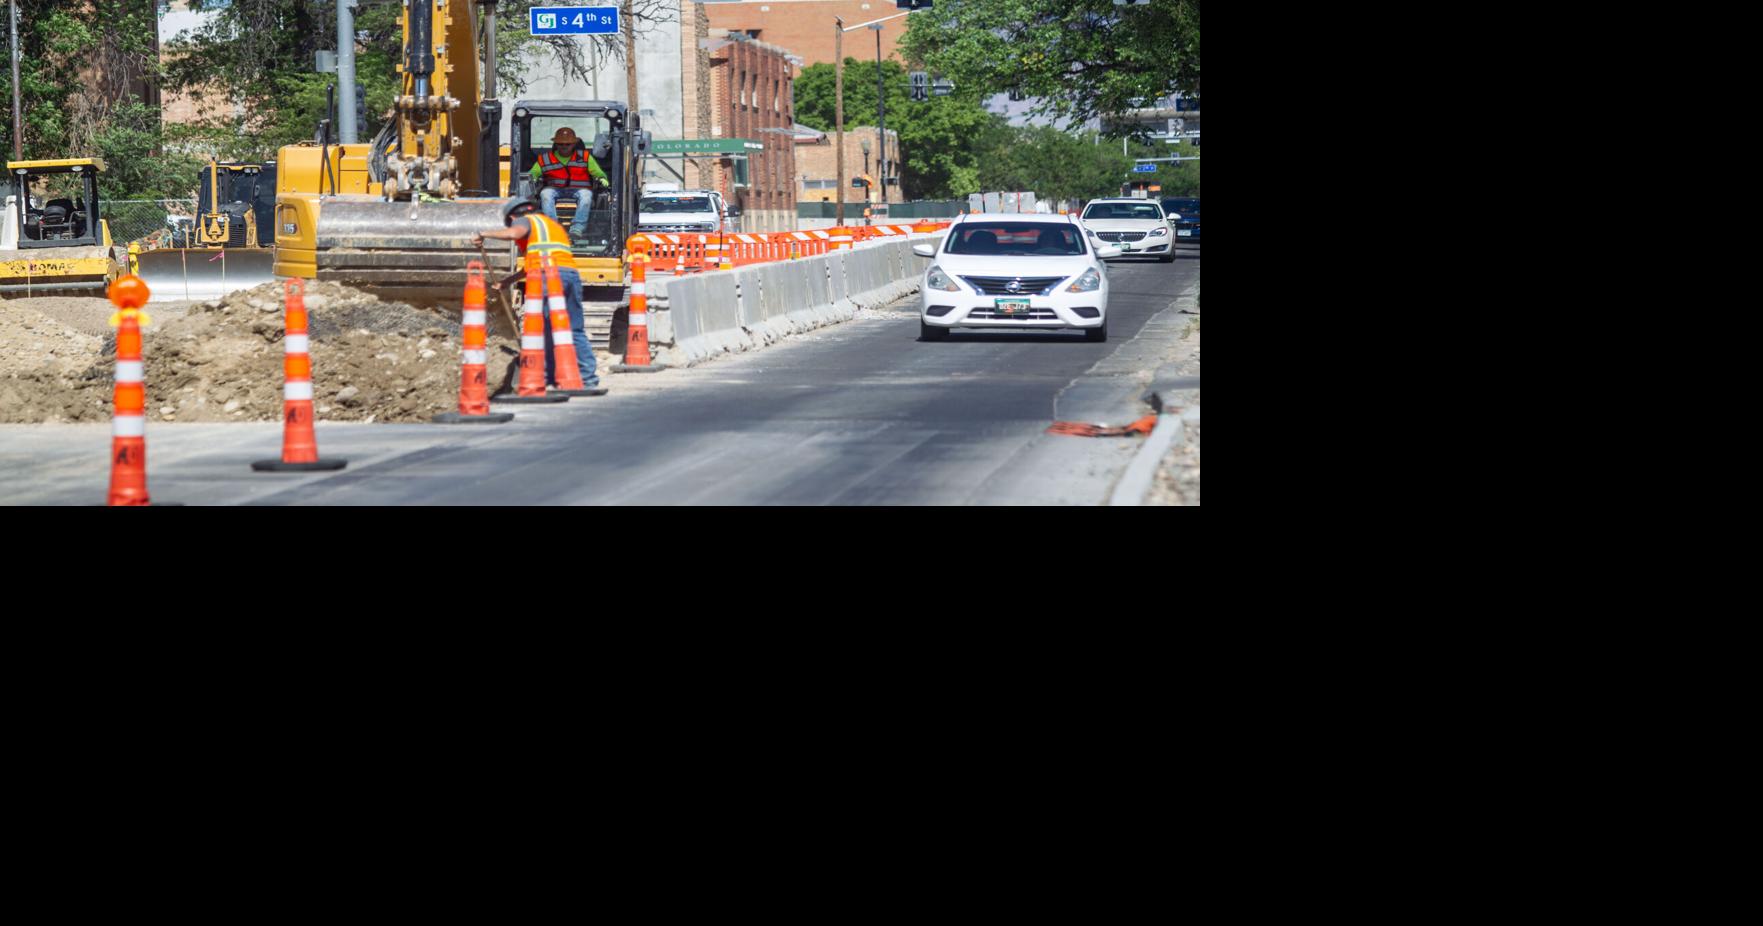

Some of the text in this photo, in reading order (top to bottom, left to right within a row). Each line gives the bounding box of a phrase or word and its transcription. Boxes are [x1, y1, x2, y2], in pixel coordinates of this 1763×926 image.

[561, 16, 568, 25] S
[571, 12, 597, 28] 4th
[601, 16, 612, 25] St
